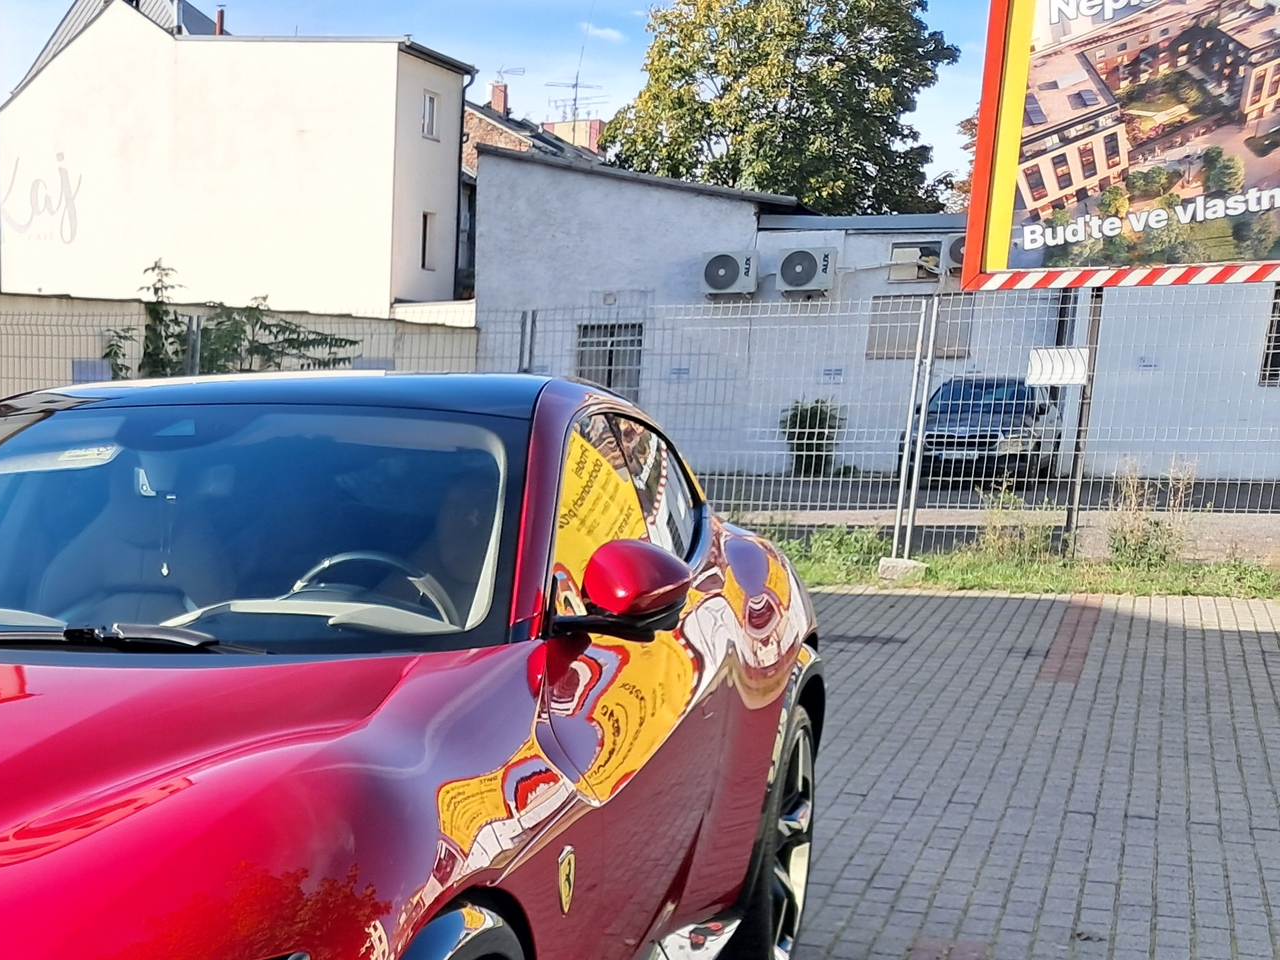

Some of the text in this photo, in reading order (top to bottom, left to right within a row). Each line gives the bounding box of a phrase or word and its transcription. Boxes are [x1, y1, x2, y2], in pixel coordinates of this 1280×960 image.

[1023, 214, 1122, 251] Buďte
[1128, 207, 1169, 232] ve
[744, 256, 752, 278] AUX
[821, 253, 830, 275] AUX
